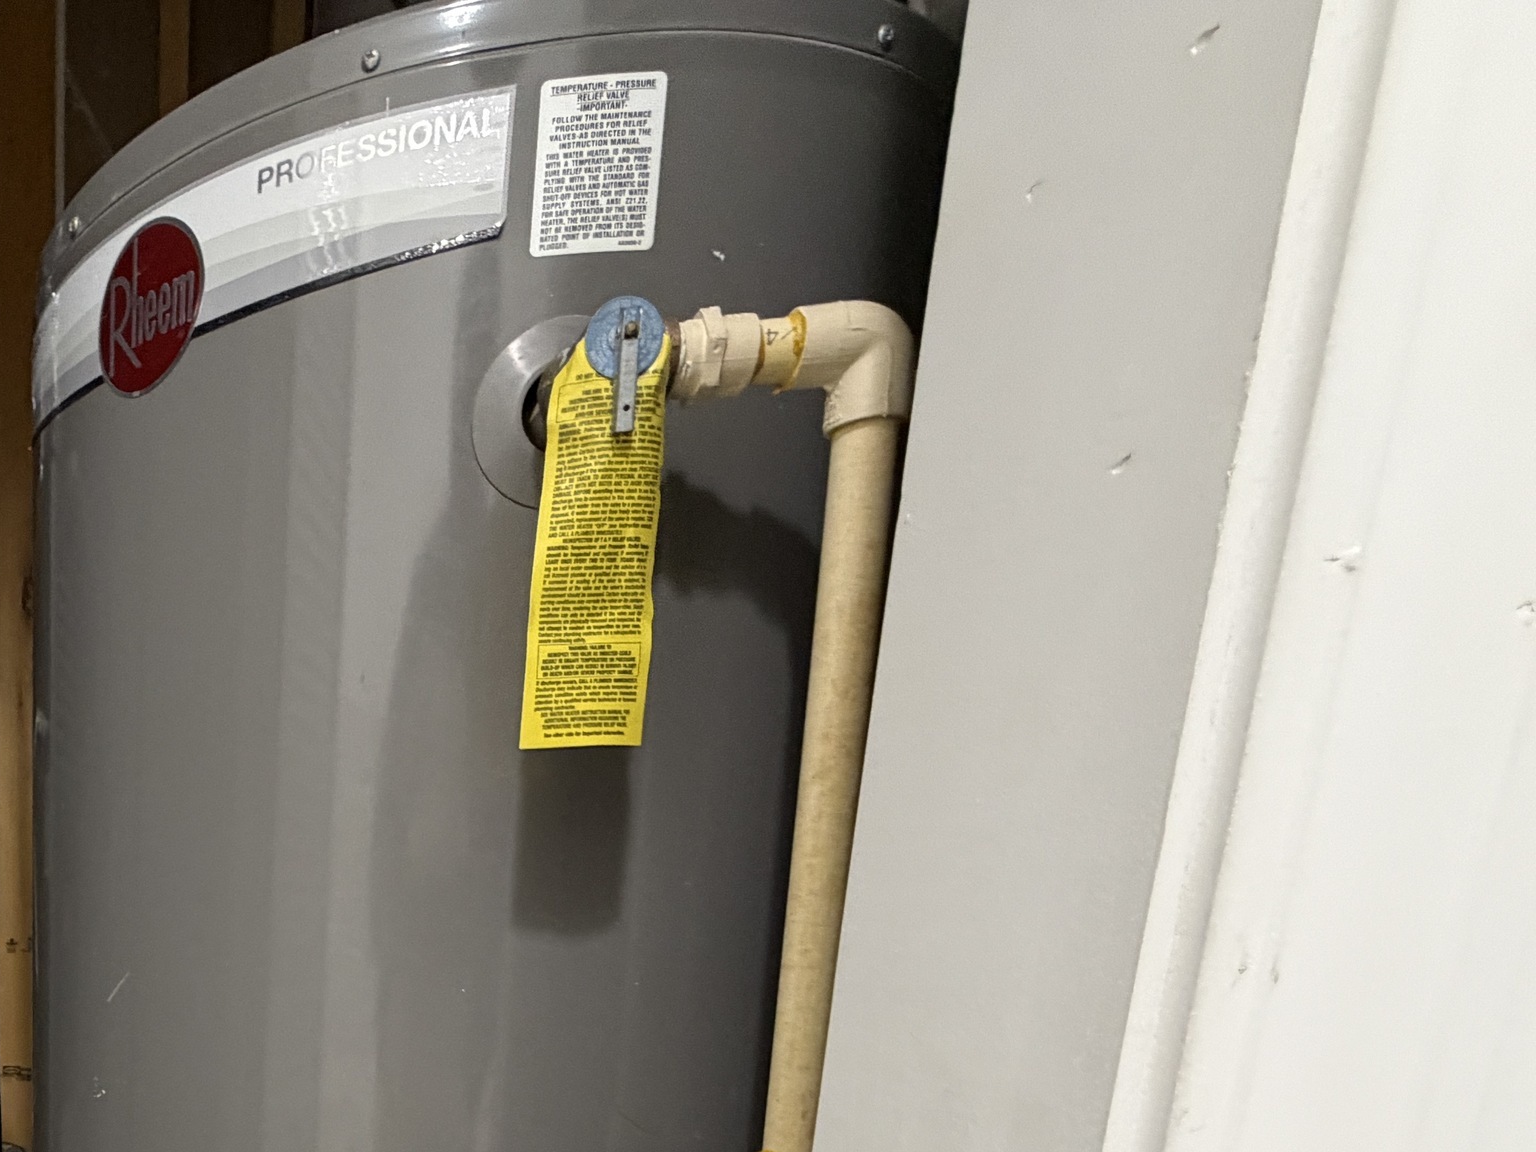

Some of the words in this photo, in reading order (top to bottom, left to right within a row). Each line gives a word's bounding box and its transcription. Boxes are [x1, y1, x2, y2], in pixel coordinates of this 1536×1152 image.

[551, 82, 608, 94] TEMPERATURE
[616, 79, 656, 88] PRESSURE
[578, 92, 604, 102] RELIEF
[606, 91, 629, 99] VALVE
[552, 116, 582, 124] FOLLOW
[601, 111, 652, 119] MAINTENANCE
[555, 123, 604, 132] PROCEDURES
[591, 129, 626, 138] DIRECTED
[559, 139, 608, 149] INSTRUCTION
[257, 108, 497, 194] PROFESSIONAL
[587, 149, 609, 157] HEATER
[572, 157, 614, 166] TEMPERATURE
[109, 237, 195, 377] Rheem
